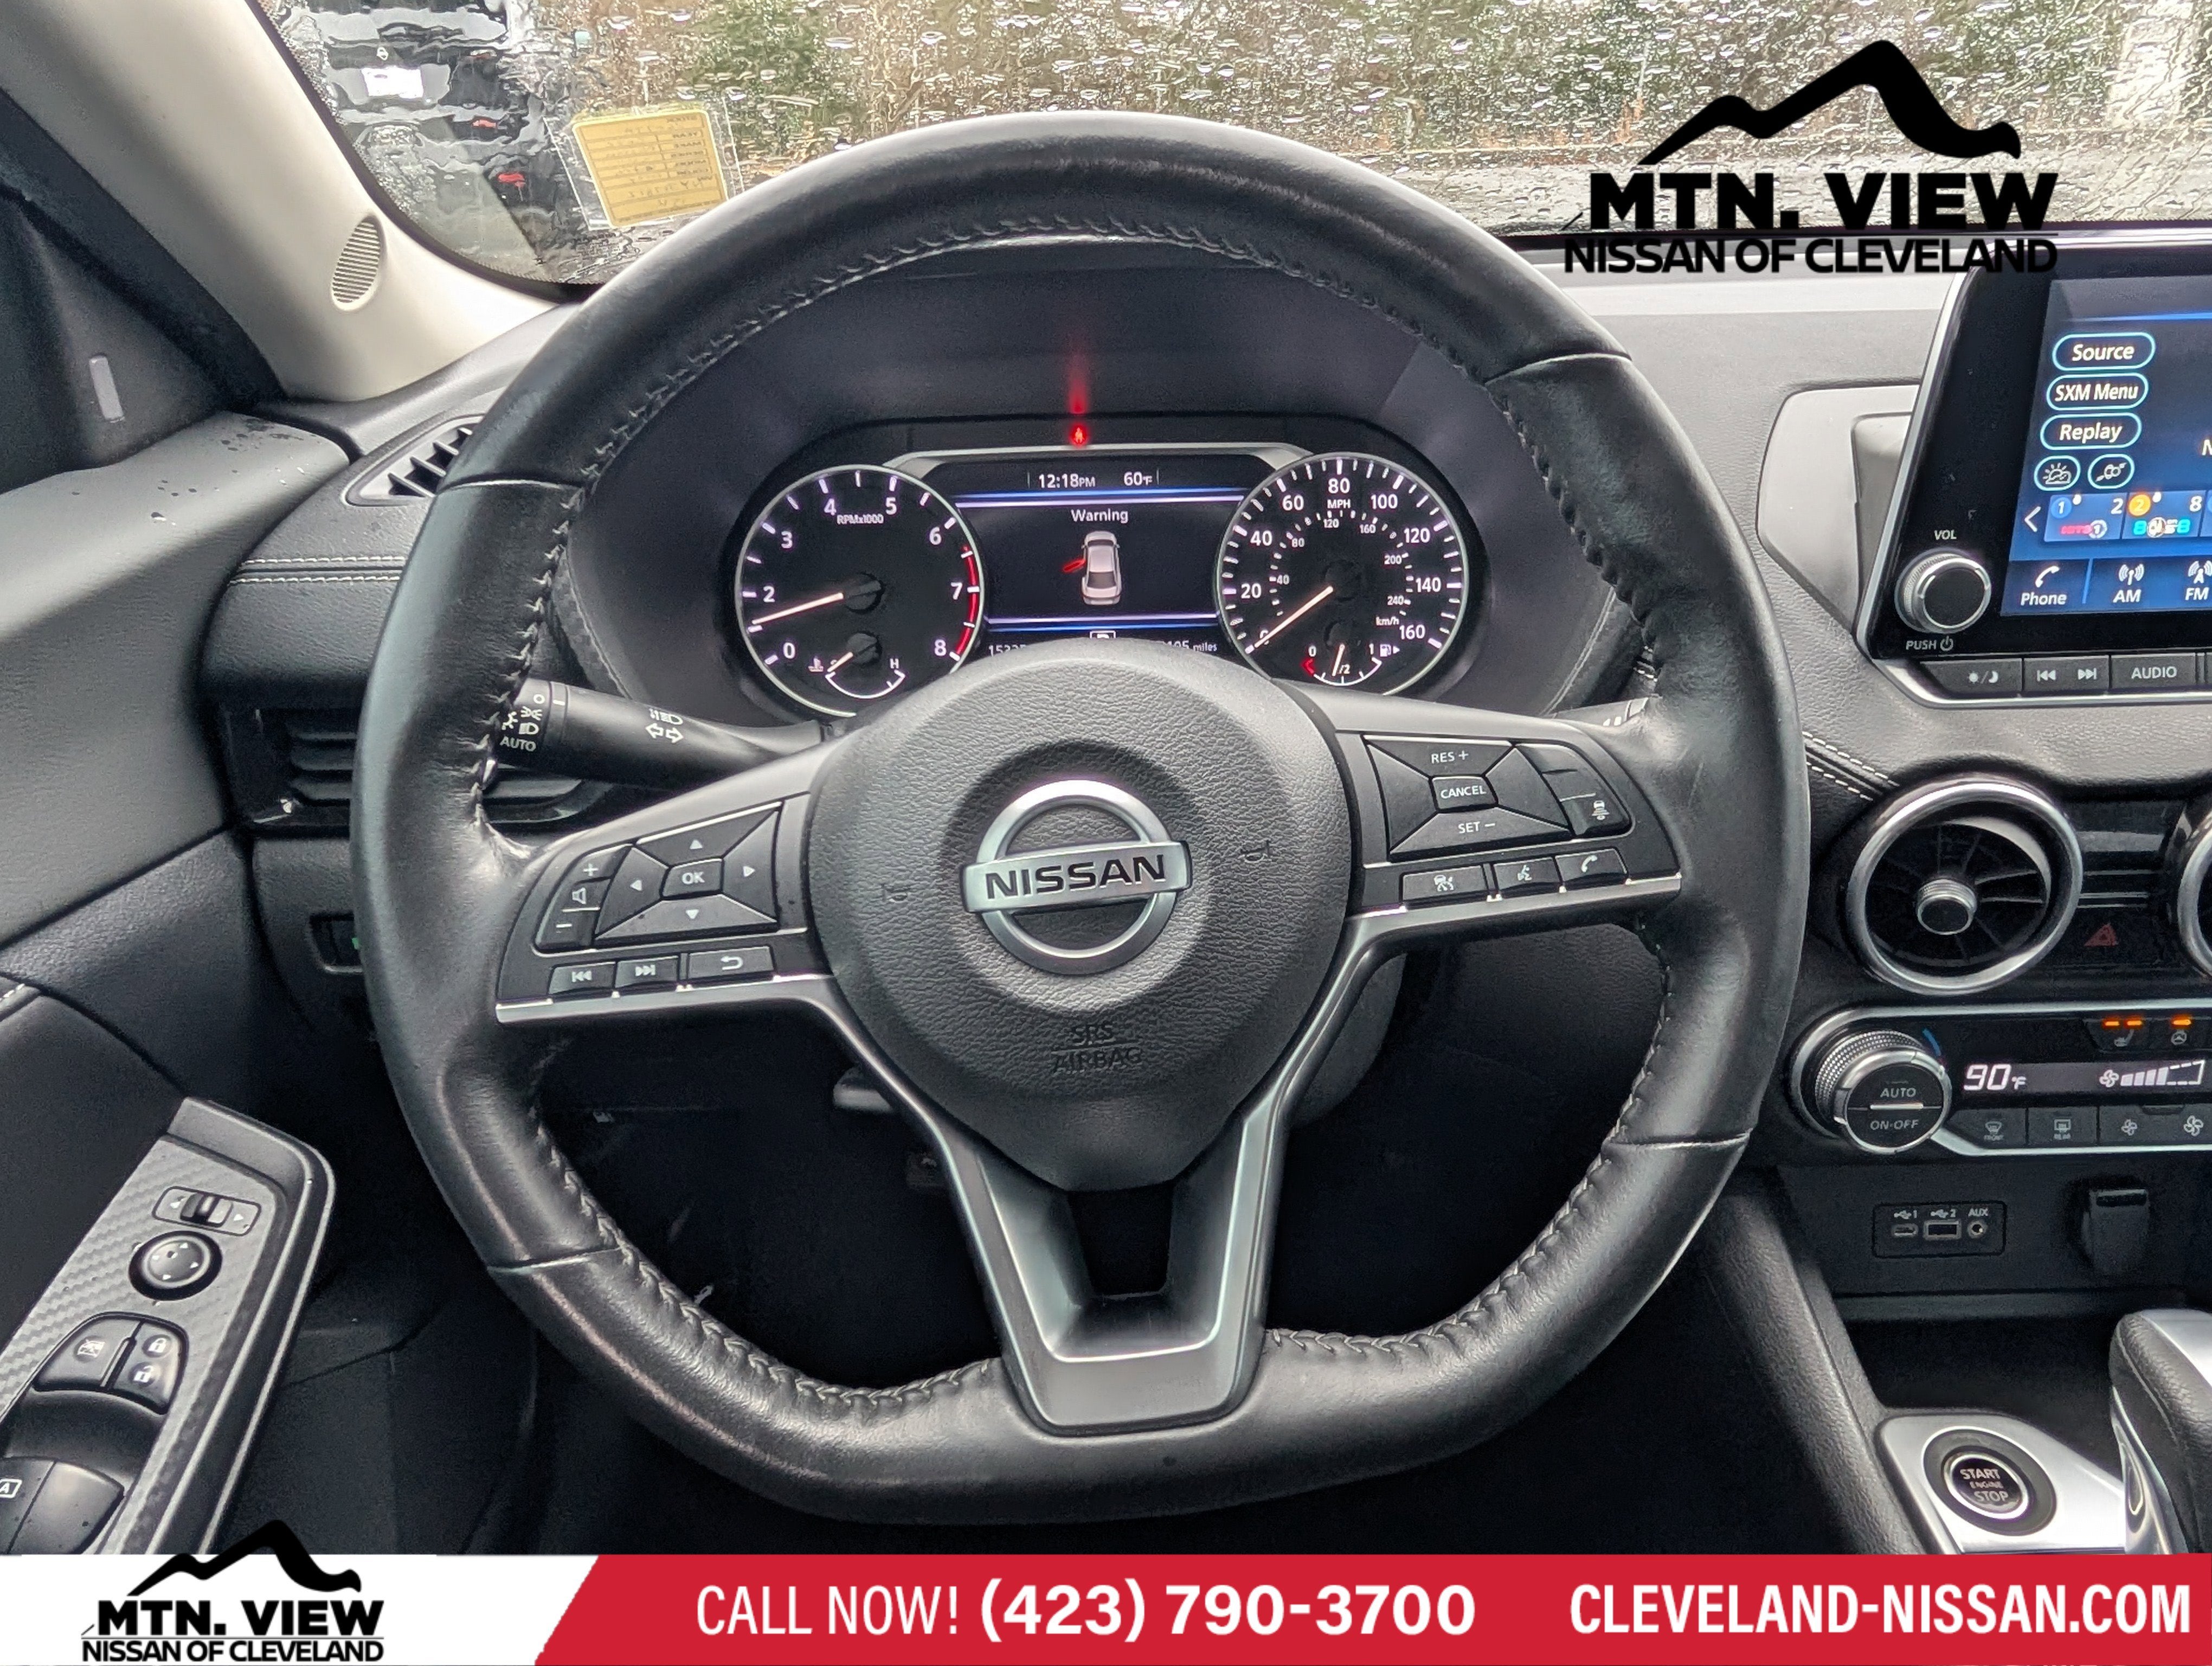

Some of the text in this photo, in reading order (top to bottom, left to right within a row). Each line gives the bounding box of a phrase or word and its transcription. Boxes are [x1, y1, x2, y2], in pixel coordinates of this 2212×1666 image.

[2072, 344, 2135, 361] Source
[2055, 383, 2139, 402] SXM Menu
[2059, 422, 2123, 444] Replay
[1328, 478, 1350, 494] 80
[824, 498, 836, 515] 4
[885, 497, 897, 515] 5
[1282, 495, 1304, 511] 60
[1327, 499, 1351, 509] MPH
[1371, 494, 1398, 509] 100
[2111, 498, 2124, 515] 2
[2189, 496, 2202, 512] 8
[1071, 509, 1128, 523] Warning
[1323, 518, 1339, 529] 120
[1360, 524, 1376, 534] 160
[781, 531, 793, 548] 3
[929, 527, 941, 544] 6
[1250, 530, 1272, 546] 40
[1404, 527, 1430, 543] 120
[1934, 530, 1957, 540] VOL
[1291, 538, 1305, 548] 80
[1384, 555, 1402, 565] 200
[1276, 575, 1289, 585] 40
[1416, 577, 1441, 593] 140
[763, 586, 775, 602] 2
[950, 582, 962, 599] 7
[1240, 583, 1262, 598] 20
[2113, 589, 2142, 603] AM
[2185, 587, 2209, 600] FM
[1387, 596, 1404, 605] 240
[2021, 592, 2067, 606] Phone
[1375, 616, 1399, 626] km/h
[1399, 624, 1425, 639] 160
[783, 642, 795, 659] 0
[934, 639, 947, 656] 8
[1193, 641, 1218, 651] miles
[1308, 645, 1316, 657] 0
[1369, 643, 1374, 655] 1
[1906, 640, 1937, 651] PUSH
[890, 658, 899, 669] H
[2131, 666, 2177, 680] AUDIO
[499, 736, 536, 752] AUTO
[1431, 752, 1455, 764] RES
[1440, 785, 1487, 799] CANCEL
[1457, 822, 1480, 834] SET
[681, 872, 705, 885] OK
[986, 854, 1166, 900] NISSAN
[1053, 1047, 1143, 1074] AIRBAG
[1880, 1087, 1916, 1098] AUTO
[1968, 1208, 1988, 1216] AUX
[1960, 1468, 2001, 1479] START
[1974, 1490, 2009, 1502] STOP
